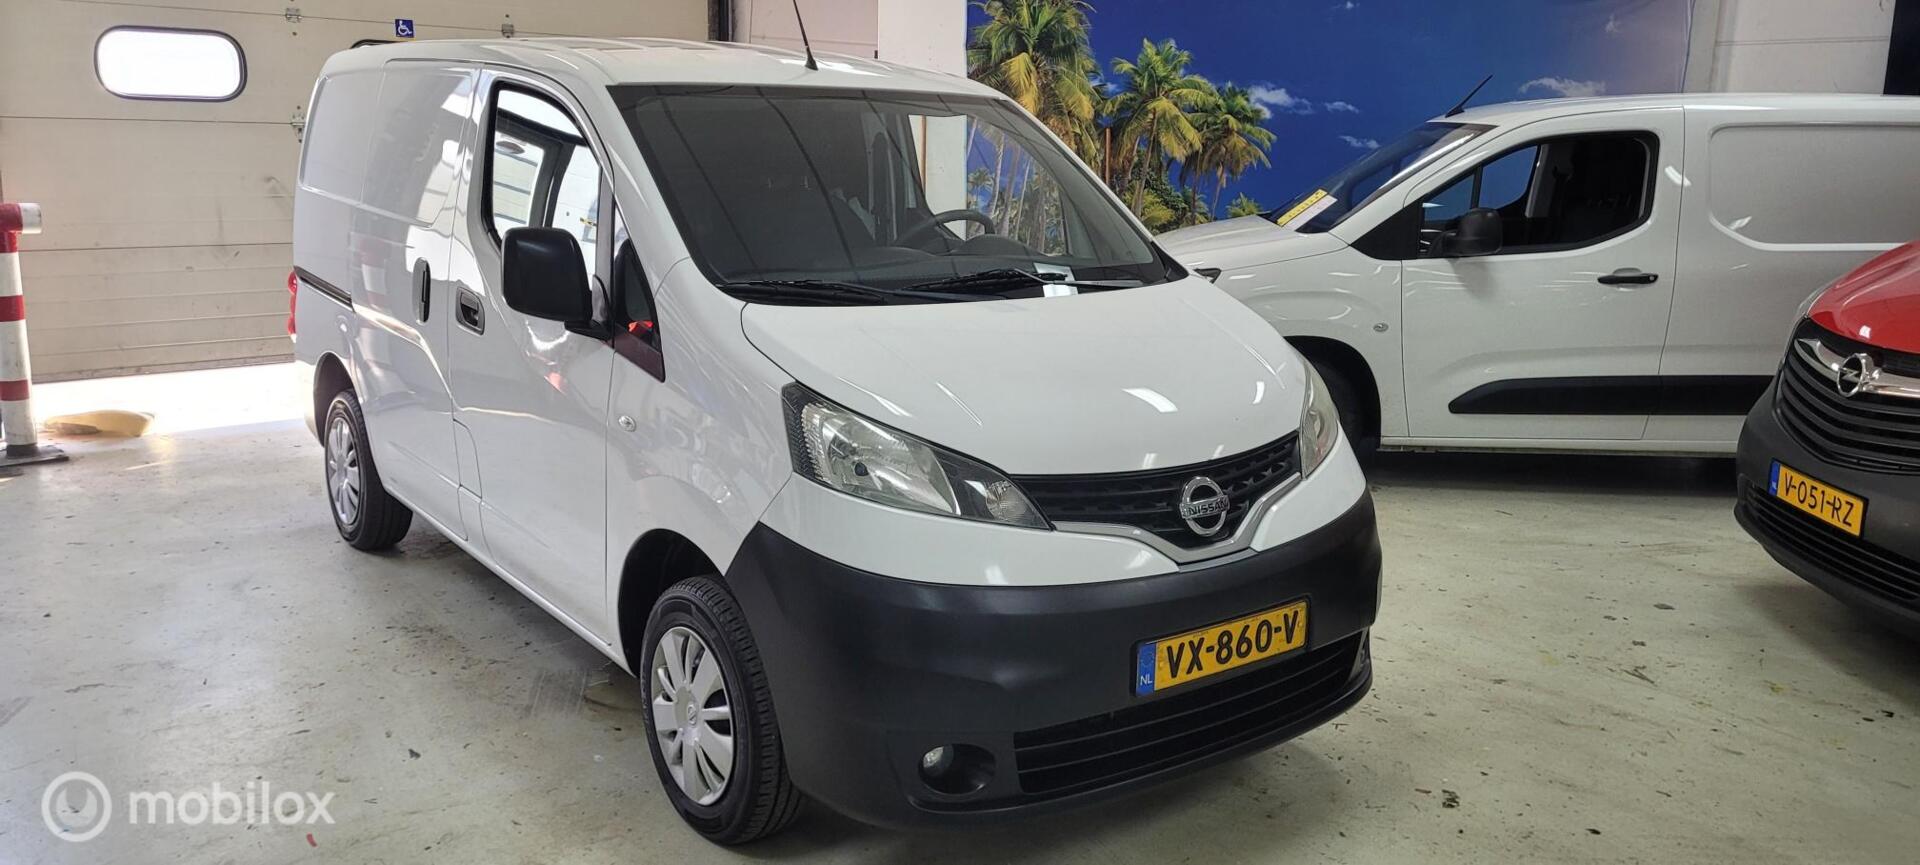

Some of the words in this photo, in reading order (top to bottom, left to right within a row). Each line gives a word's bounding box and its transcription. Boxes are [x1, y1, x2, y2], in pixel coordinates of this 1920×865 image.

[1188, 497, 1228, 515] NISSAN
[1784, 472, 1854, 527] V-051-RZ
[1140, 674, 1153, 686] NL
[1167, 610, 1299, 679] VX-860-V
